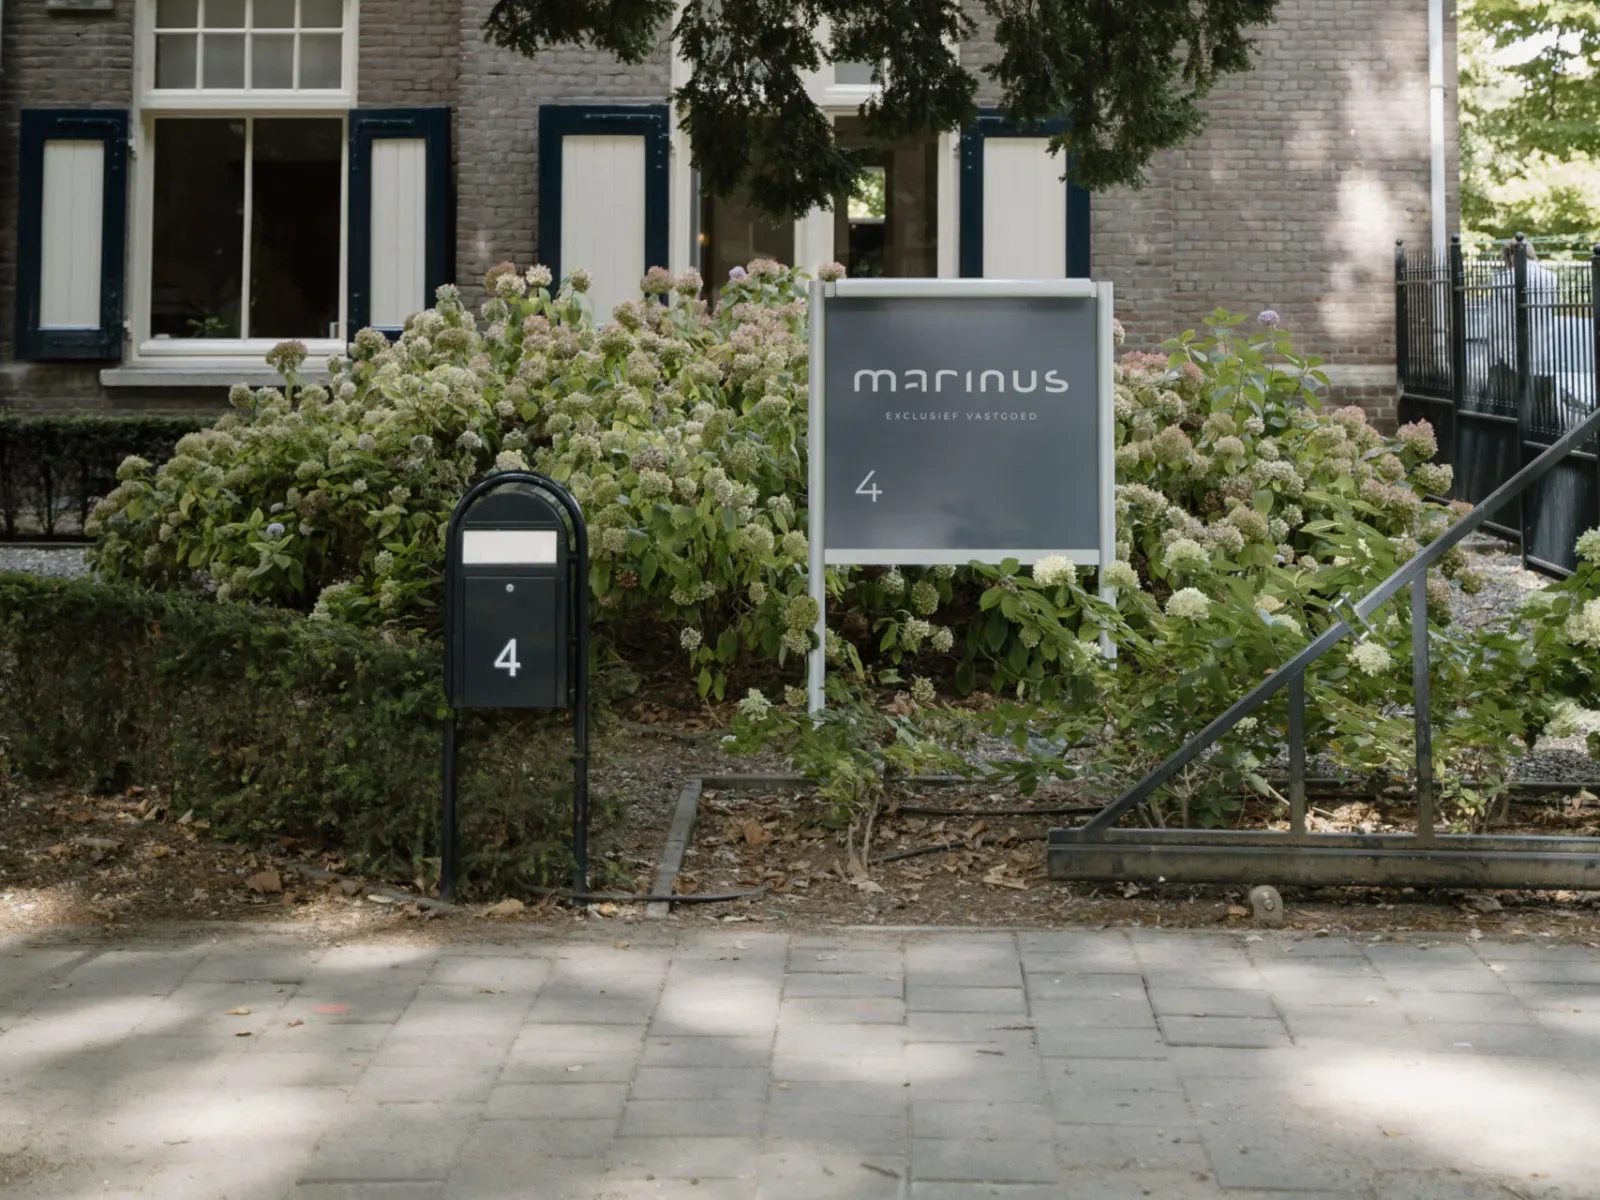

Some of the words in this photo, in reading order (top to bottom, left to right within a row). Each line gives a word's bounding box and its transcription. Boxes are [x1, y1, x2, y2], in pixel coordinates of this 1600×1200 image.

[853, 369, 1069, 394] marinus
[885, 411, 959, 421] EXCLUSIEF
[966, 412, 1037, 421] VASTGOED
[854, 470, 883, 503] 4
[493, 637, 522, 678] 4
